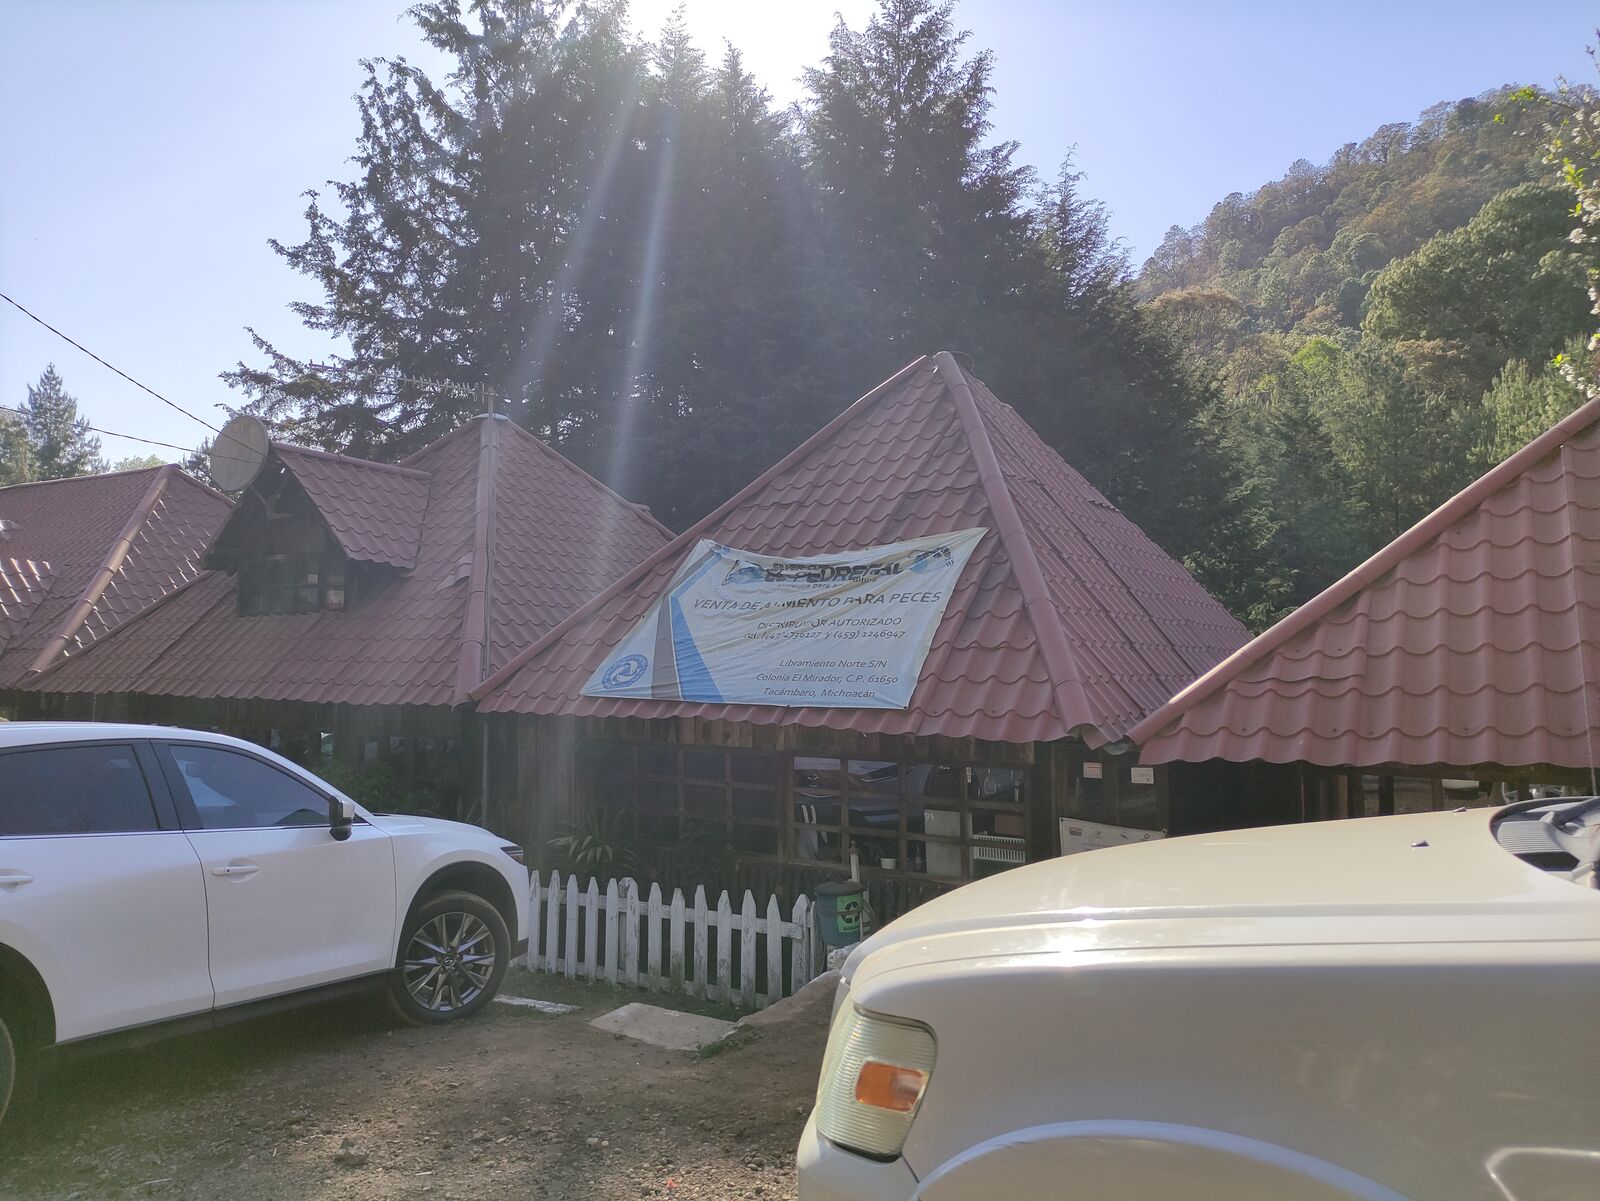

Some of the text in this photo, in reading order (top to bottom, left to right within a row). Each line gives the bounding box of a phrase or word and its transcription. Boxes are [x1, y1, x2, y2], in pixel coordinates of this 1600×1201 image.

[694, 598, 737, 610] VENTA
[738, 601, 761, 610] DE
[888, 591, 942, 603] PECES
[828, 618, 903, 627] AUTORIZADO
[834, 630, 860, 639] (459)
[861, 630, 906, 639] 1246947
[779, 659, 888, 669] Libramiento Norte S/N
[756, 672, 899, 685] Colonia El Mirador, C.P. 61650
[763, 687, 876, 699] Tacámbaro, Michoacán
